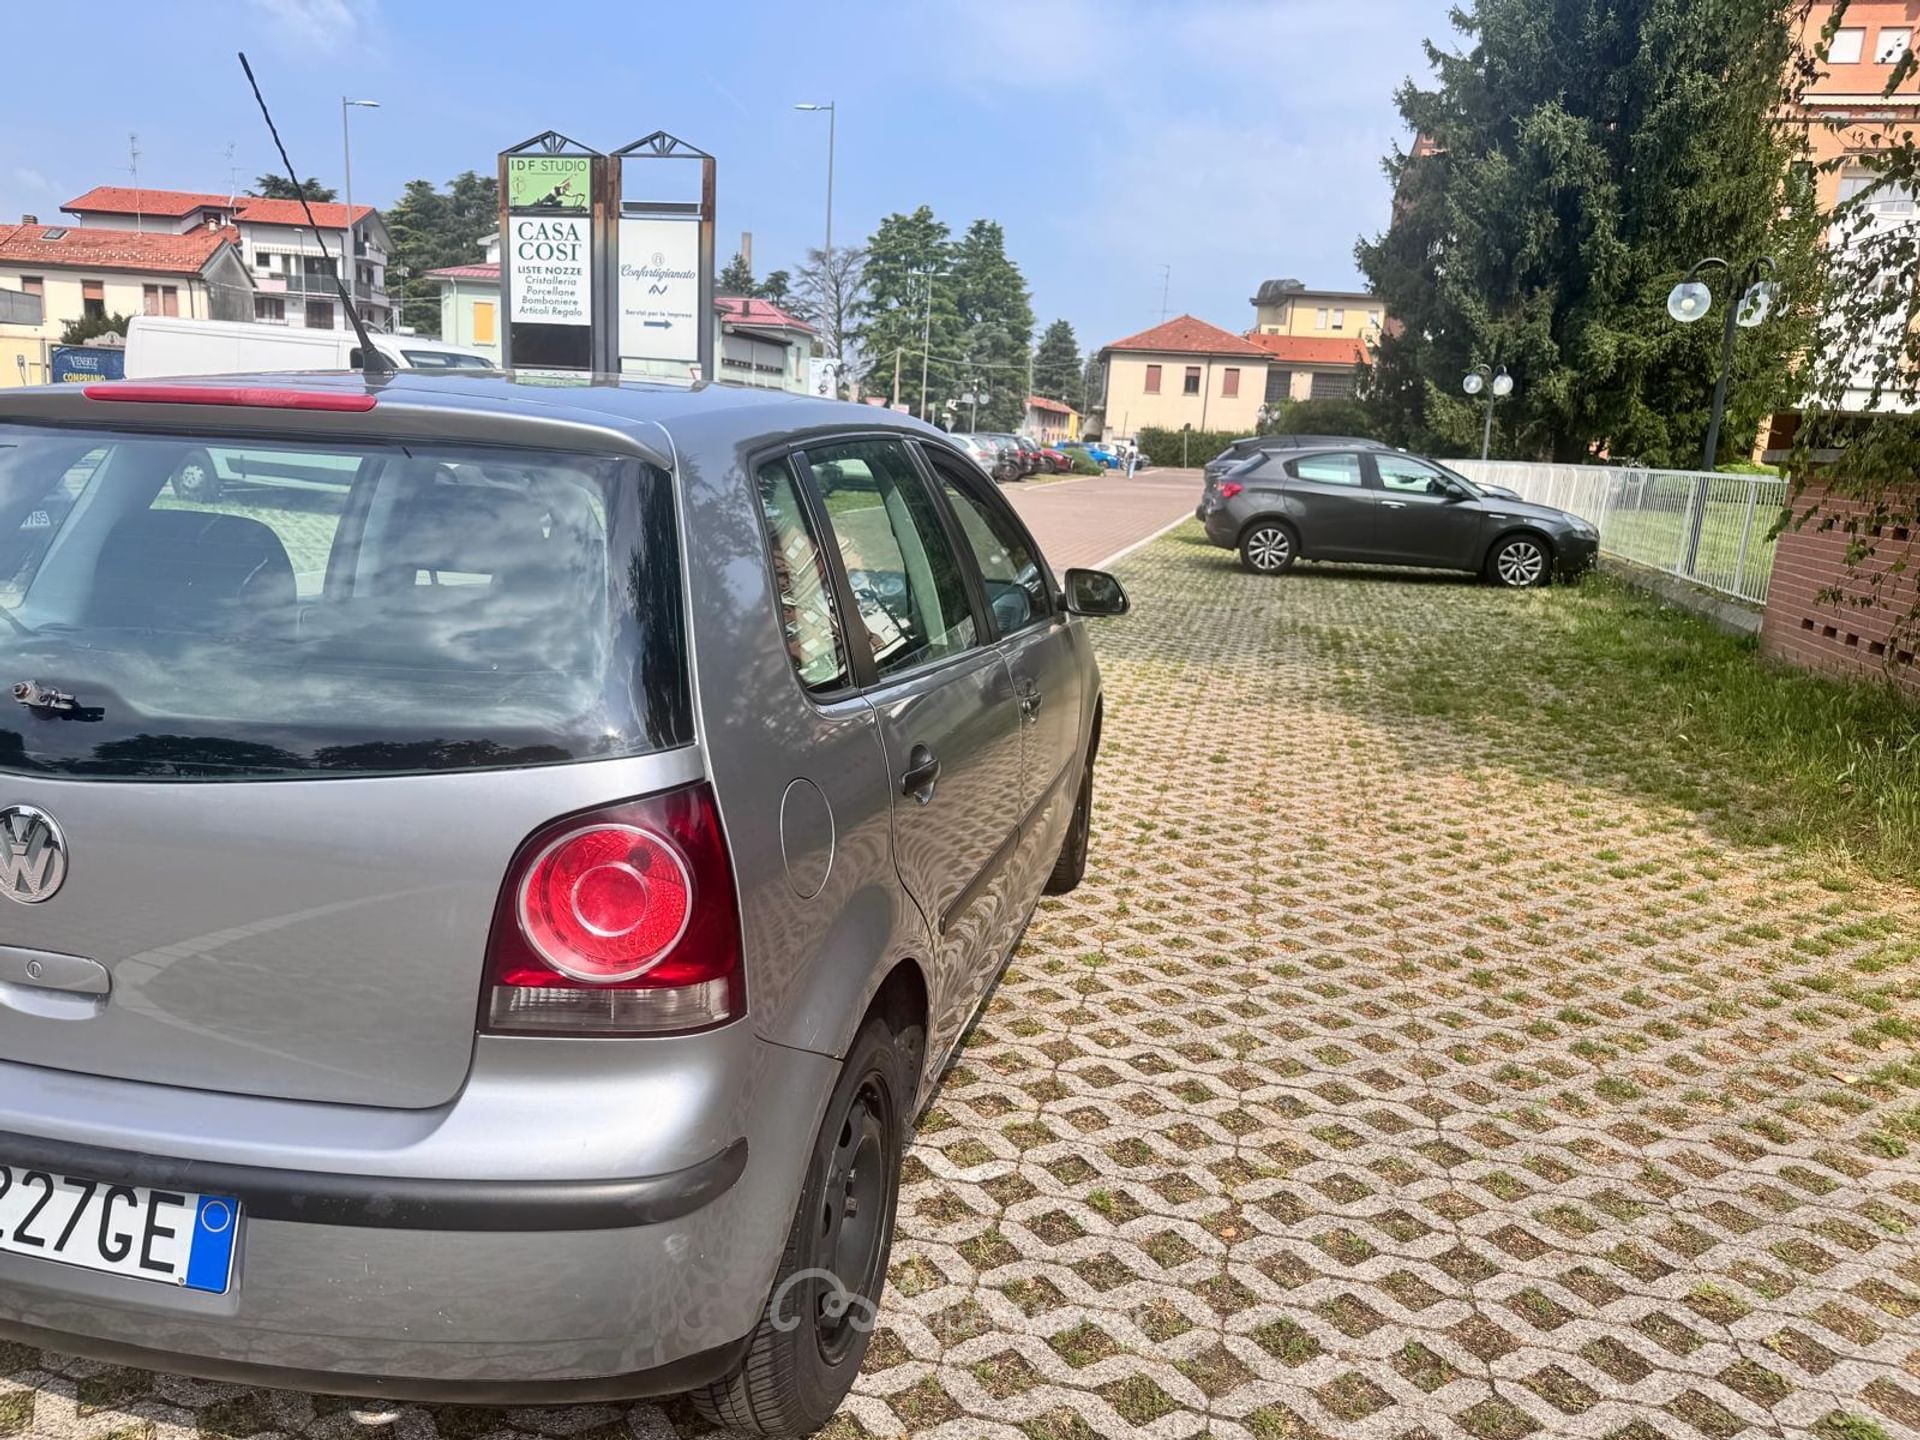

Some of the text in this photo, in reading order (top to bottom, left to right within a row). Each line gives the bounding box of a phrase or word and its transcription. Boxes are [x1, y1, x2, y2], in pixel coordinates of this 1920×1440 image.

[541, 160, 587, 172] STUDIO
[518, 221, 581, 241] CASA
[518, 266, 582, 275] LISTE NOZZE
[620, 264, 696, 282] Confartigianato
[525, 275, 577, 286] Cristalleria
[526, 285, 576, 296] Porcellane
[522, 295, 578, 306] Bomboniere
[519, 305, 583, 318] Articoli Regalo
